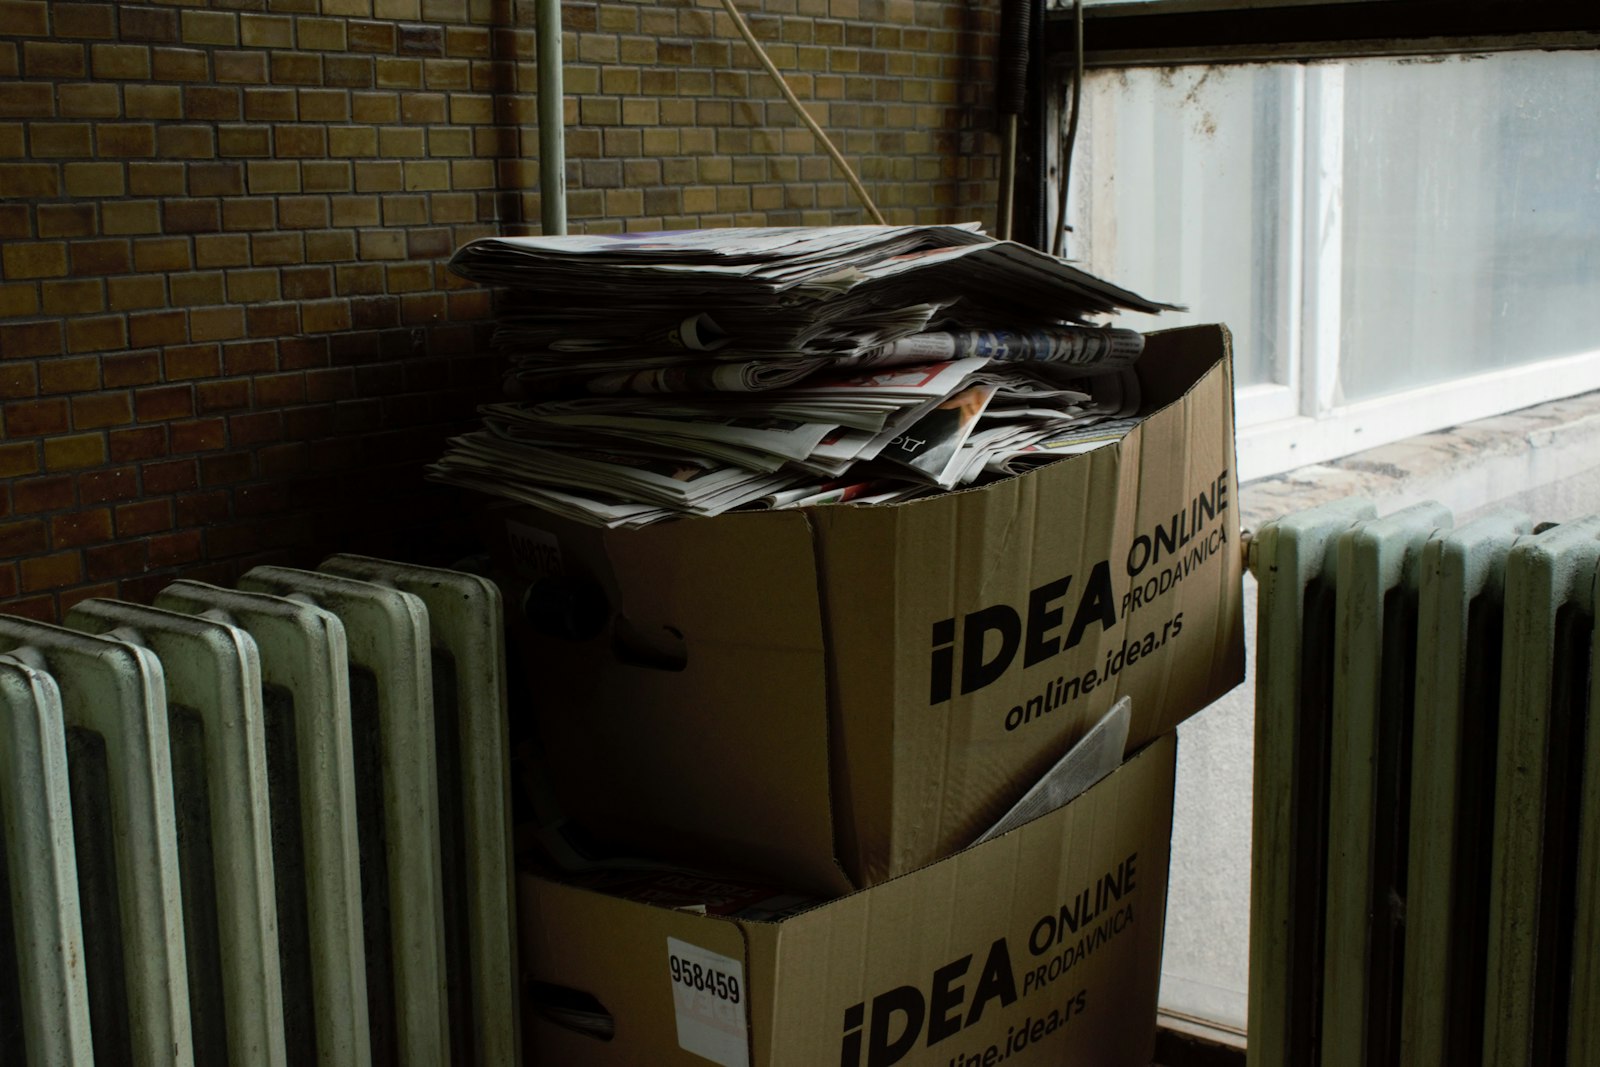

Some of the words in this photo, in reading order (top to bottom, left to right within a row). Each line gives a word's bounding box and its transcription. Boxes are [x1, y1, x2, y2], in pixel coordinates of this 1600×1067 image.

[1121, 523, 1228, 619] PRODAVNICA
[1126, 469, 1229, 578] ONLINE
[930, 560, 1117, 706] iDEA
[1004, 611, 1184, 731] online.idea.rs
[1022, 903, 1135, 997] PRODAVNICA
[1028, 852, 1138, 957] ONLINE
[669, 955, 740, 1004] 958459
